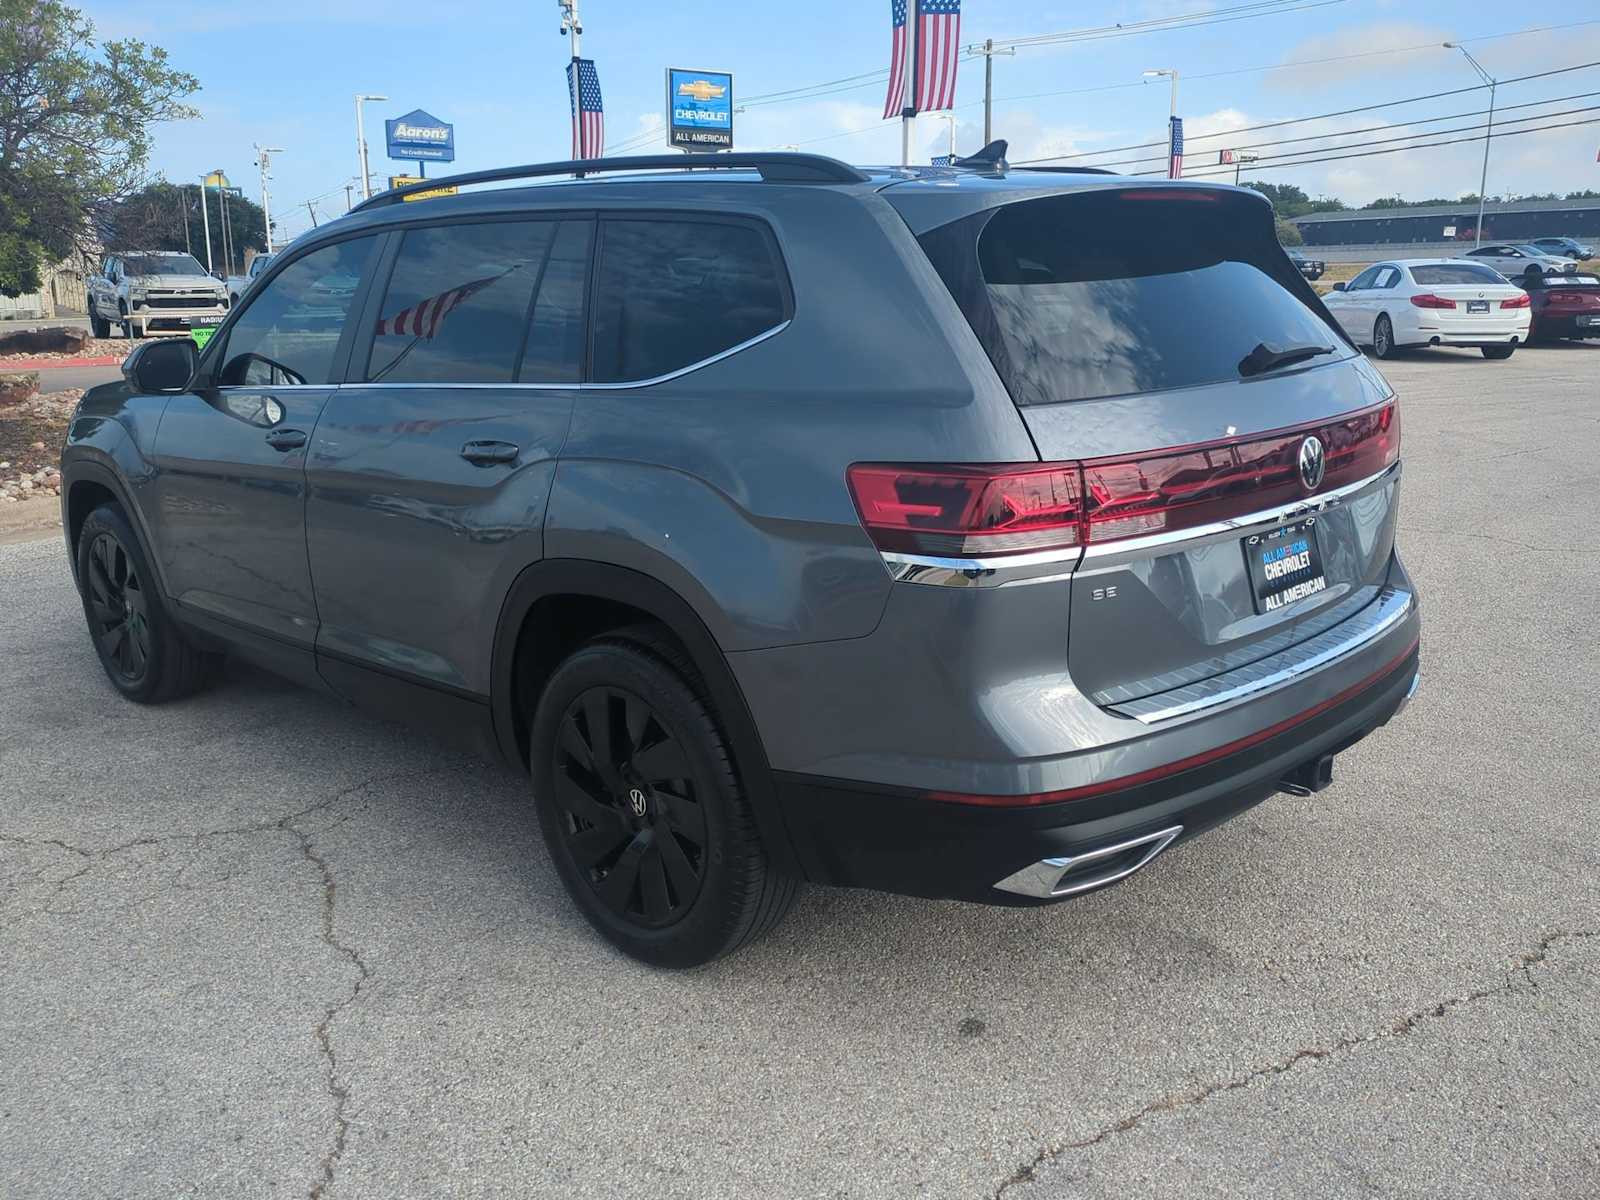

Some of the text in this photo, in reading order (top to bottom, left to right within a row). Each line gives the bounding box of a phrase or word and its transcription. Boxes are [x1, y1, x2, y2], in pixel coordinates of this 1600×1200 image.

[675, 109, 729, 121] CHEVROLET
[676, 132, 730, 144] ALL AMERICAN
[1263, 539, 1309, 564] ALL AMERICAN
[1264, 551, 1311, 581] CHEVROLET
[1092, 586, 1117, 600] SE
[1265, 591, 1283, 612] ALL
[1283, 576, 1326, 605] AMERICAN
